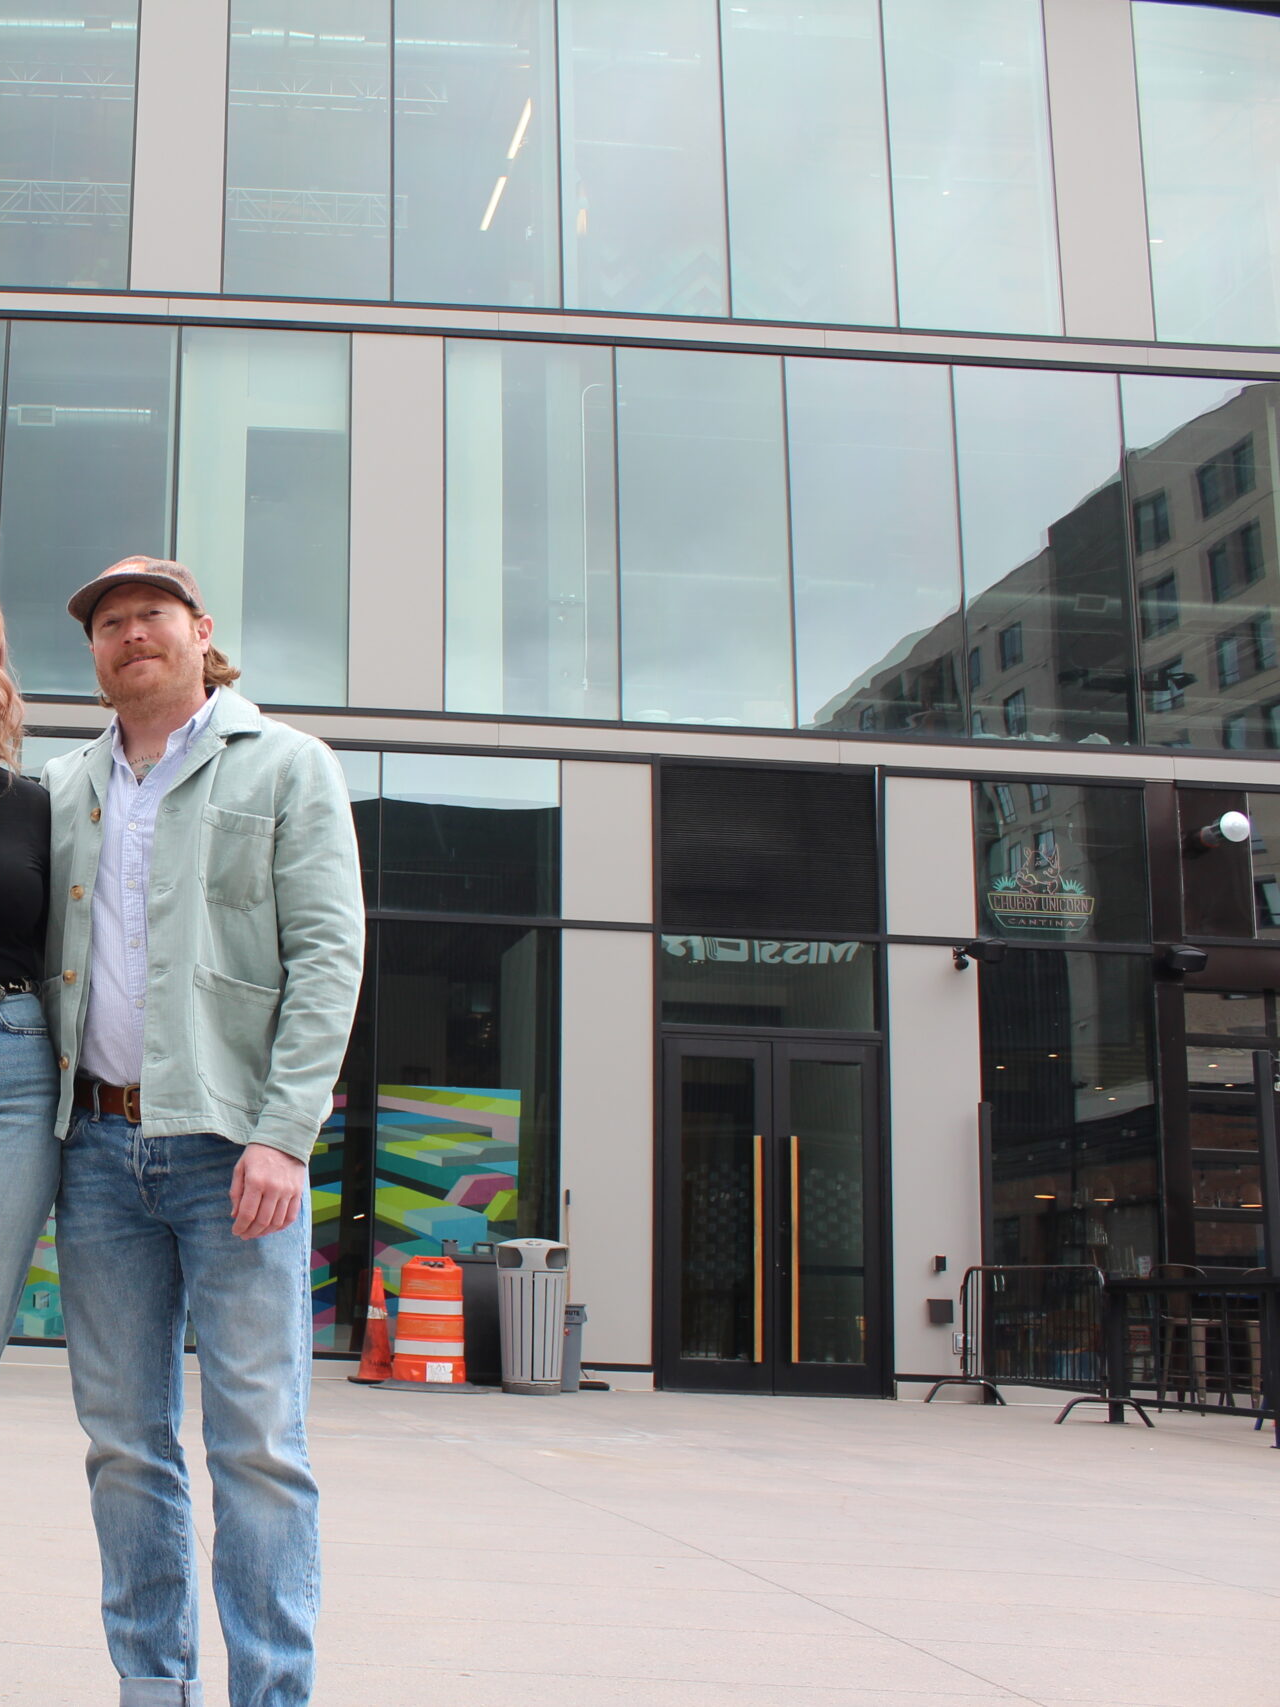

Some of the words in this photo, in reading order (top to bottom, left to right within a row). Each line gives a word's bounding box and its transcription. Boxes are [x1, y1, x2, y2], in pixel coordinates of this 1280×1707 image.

[993, 895, 1038, 911] CHUBBY
[1041, 897, 1089, 912] UNICORN
[1008, 918, 1075, 927] CANTINA
